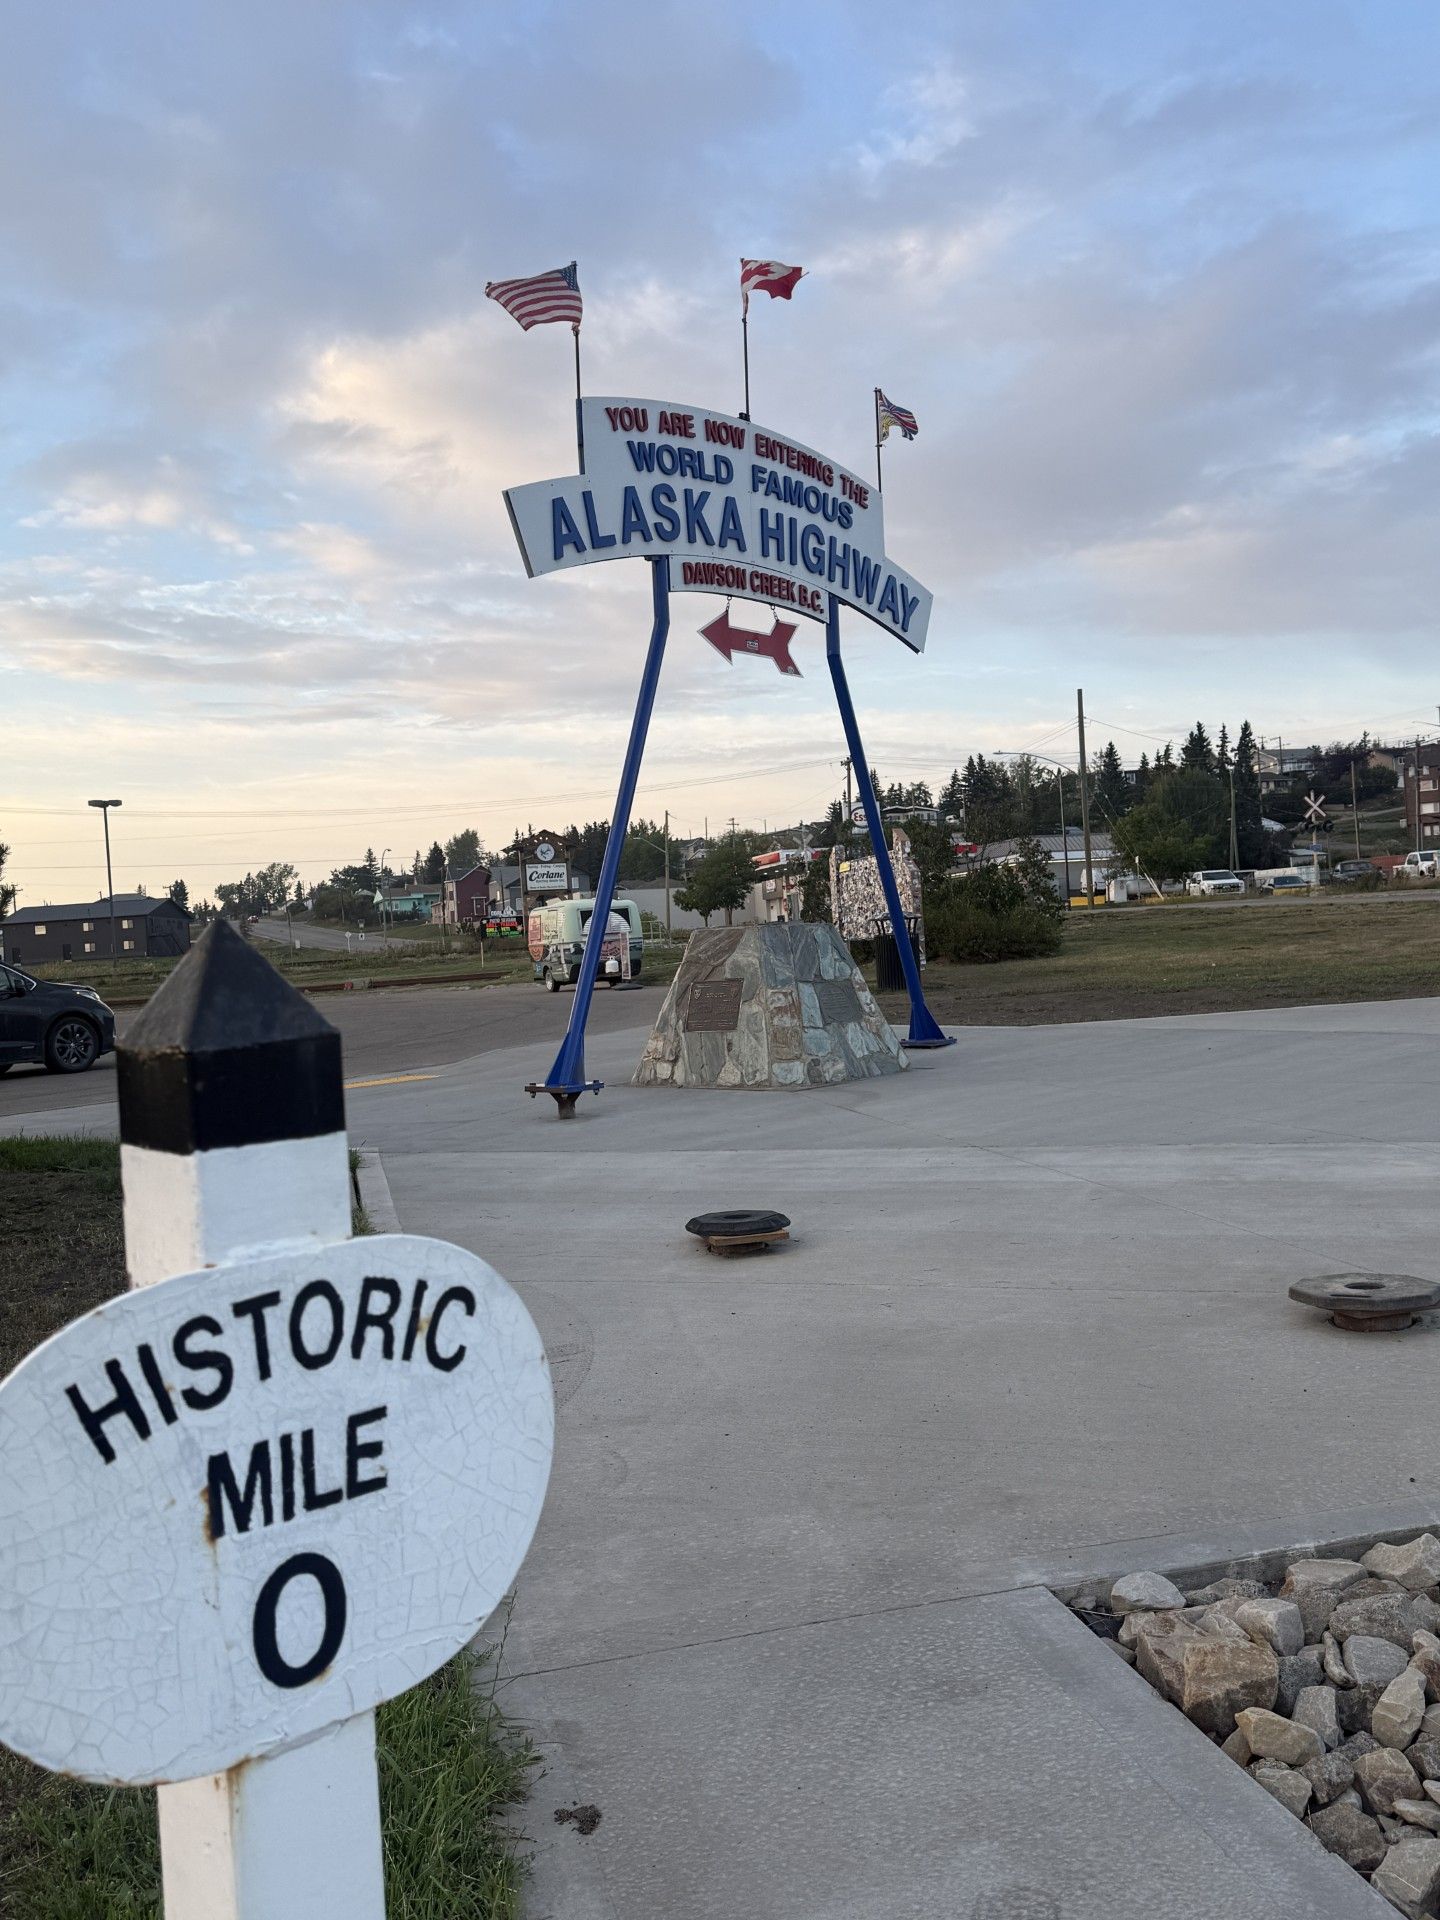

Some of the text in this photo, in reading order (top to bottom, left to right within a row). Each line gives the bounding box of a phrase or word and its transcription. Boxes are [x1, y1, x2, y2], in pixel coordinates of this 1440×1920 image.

[605, 407, 869, 509] YOU ARE NOW ENTERING THE
[627, 440, 854, 529] WORLD FAMOUS
[552, 483, 920, 632] ALASKA HIGHWAY
[682, 561, 825, 614] DAWSON CREEK B.C.
[528, 870, 565, 881] Corlane
[65, 1277, 476, 1465] HISTORIC
[206, 1405, 388, 1539] MILE
